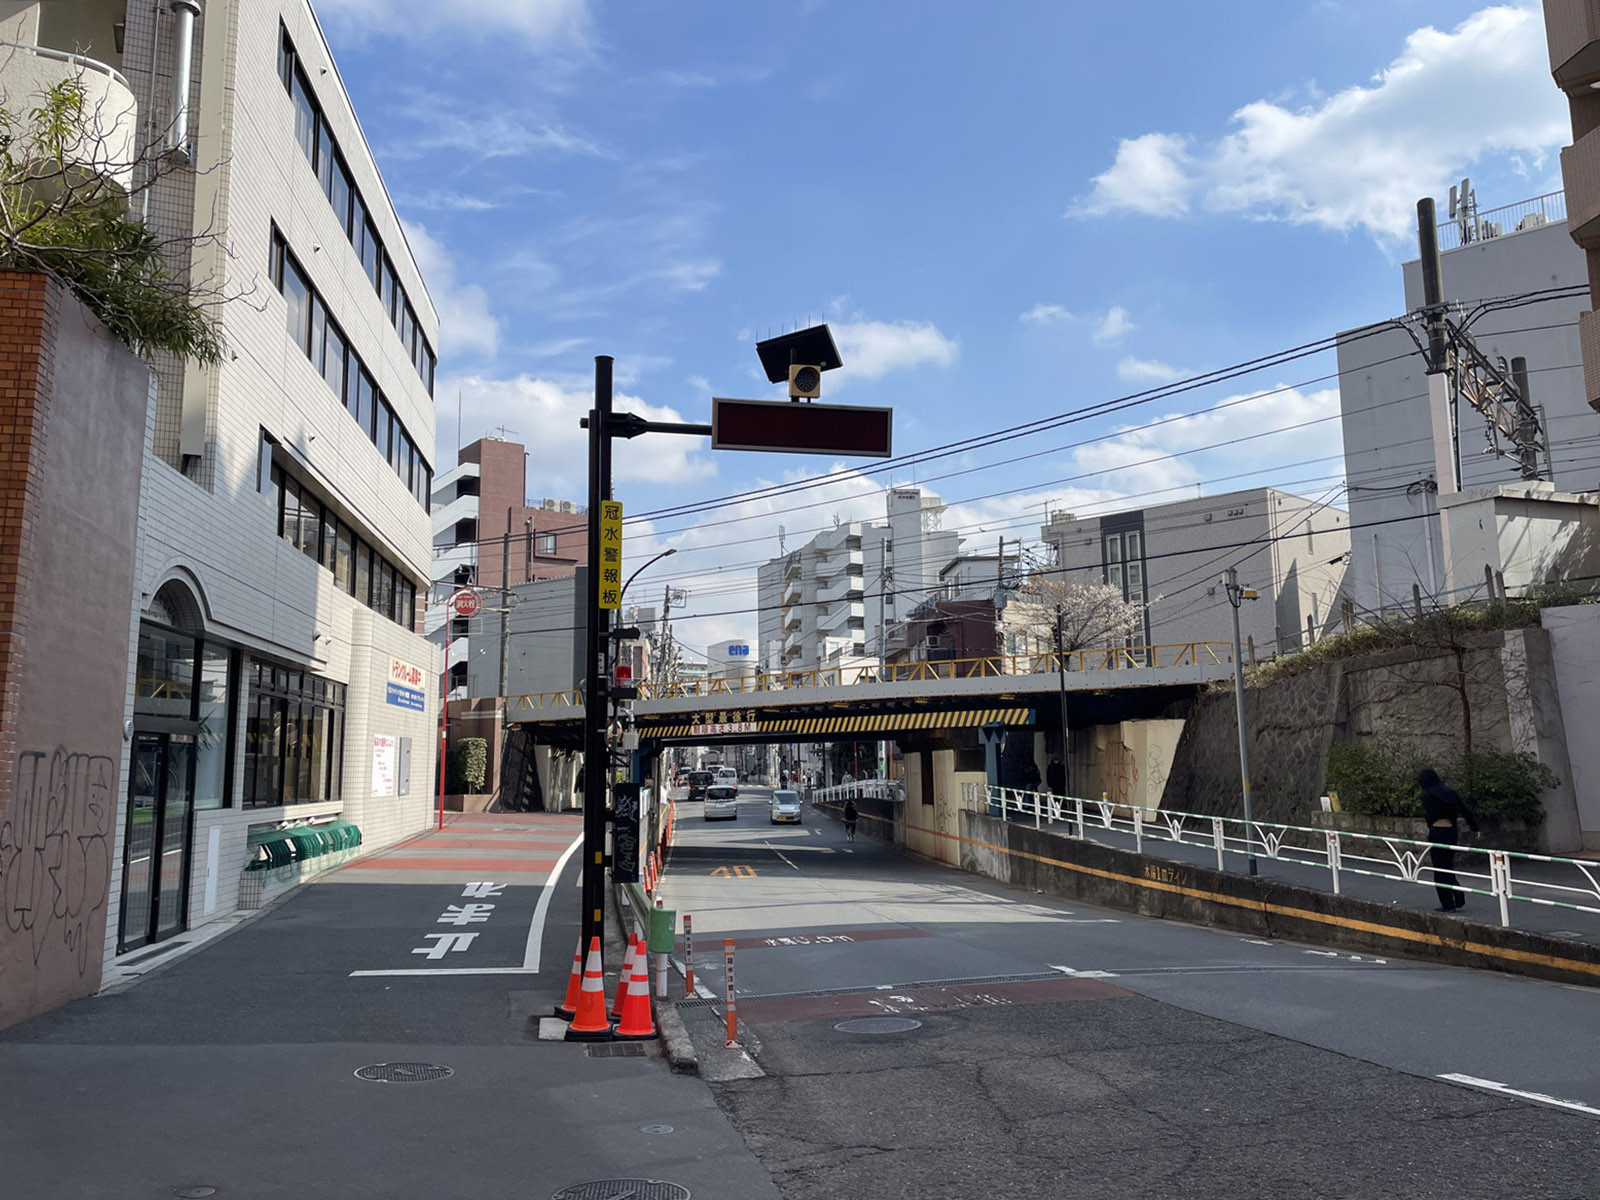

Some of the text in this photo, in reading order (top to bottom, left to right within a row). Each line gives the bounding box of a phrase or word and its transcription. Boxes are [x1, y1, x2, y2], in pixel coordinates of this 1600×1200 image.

[602, 505, 620, 604] 冠水警報板
[728, 644, 750, 656] ena
[710, 865, 758, 879] 40
[411, 881, 508, 959] 止まれ
